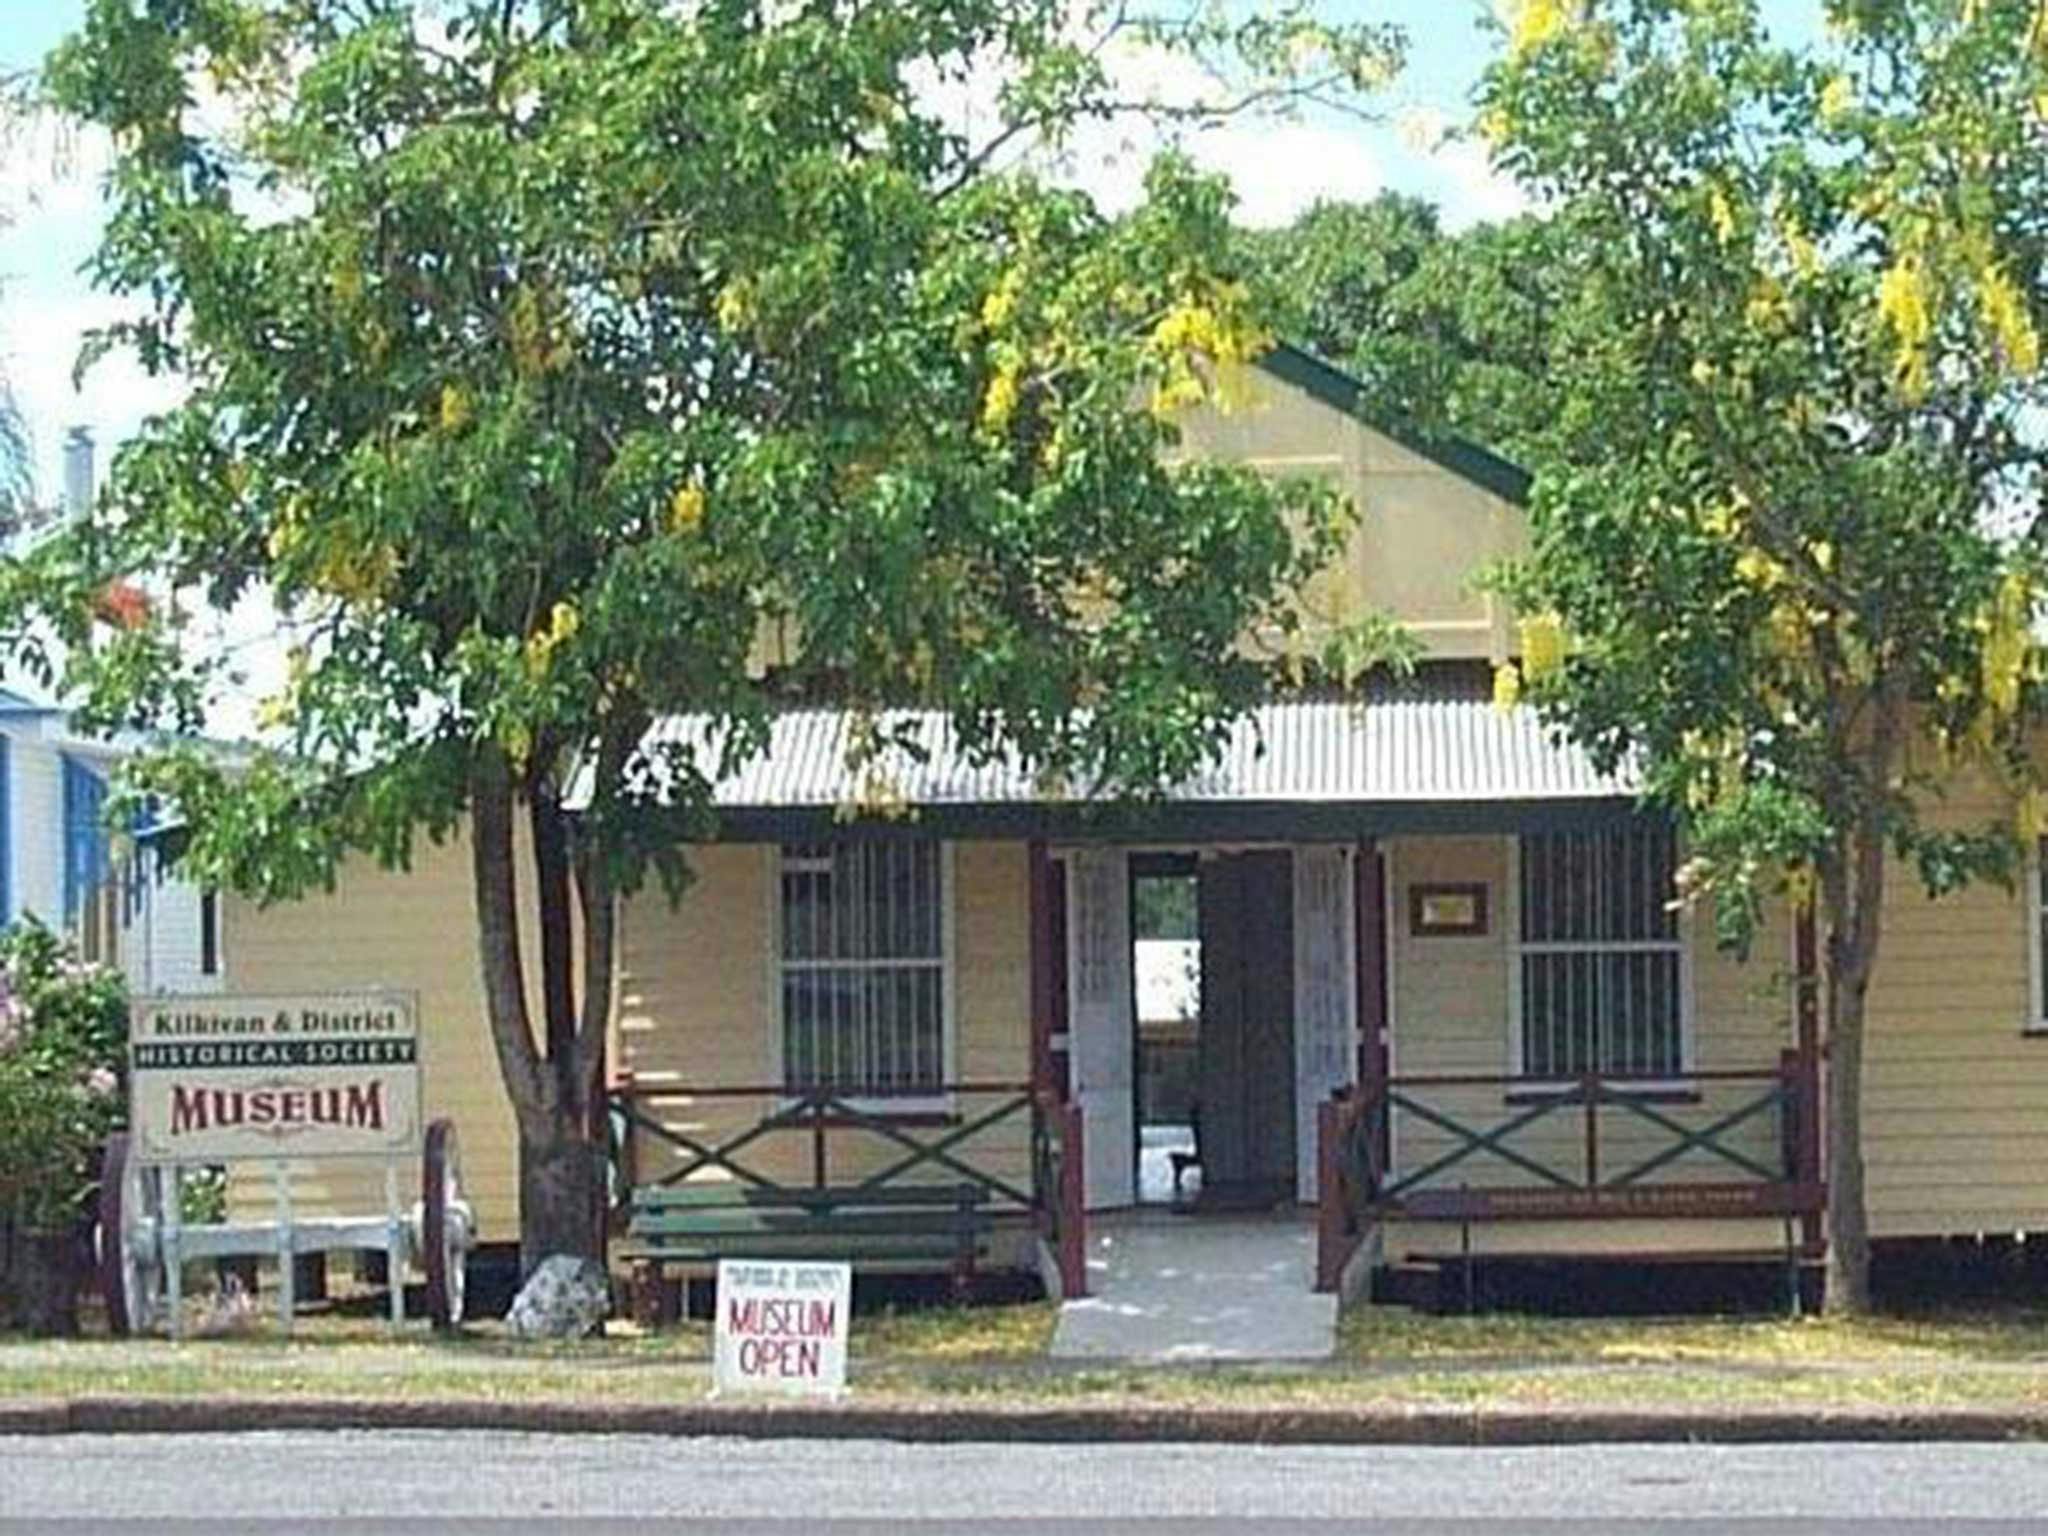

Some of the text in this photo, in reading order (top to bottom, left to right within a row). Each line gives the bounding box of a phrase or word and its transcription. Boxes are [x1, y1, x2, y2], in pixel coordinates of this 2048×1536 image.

[155, 1009, 396, 1035] Kilkivan & District
[138, 1041, 412, 1066] HISTORICAL SOCIETY
[171, 1079, 383, 1136] MUSEUM
[729, 1298, 835, 1338] MUSEUM
[740, 1338, 820, 1377] OPEN
